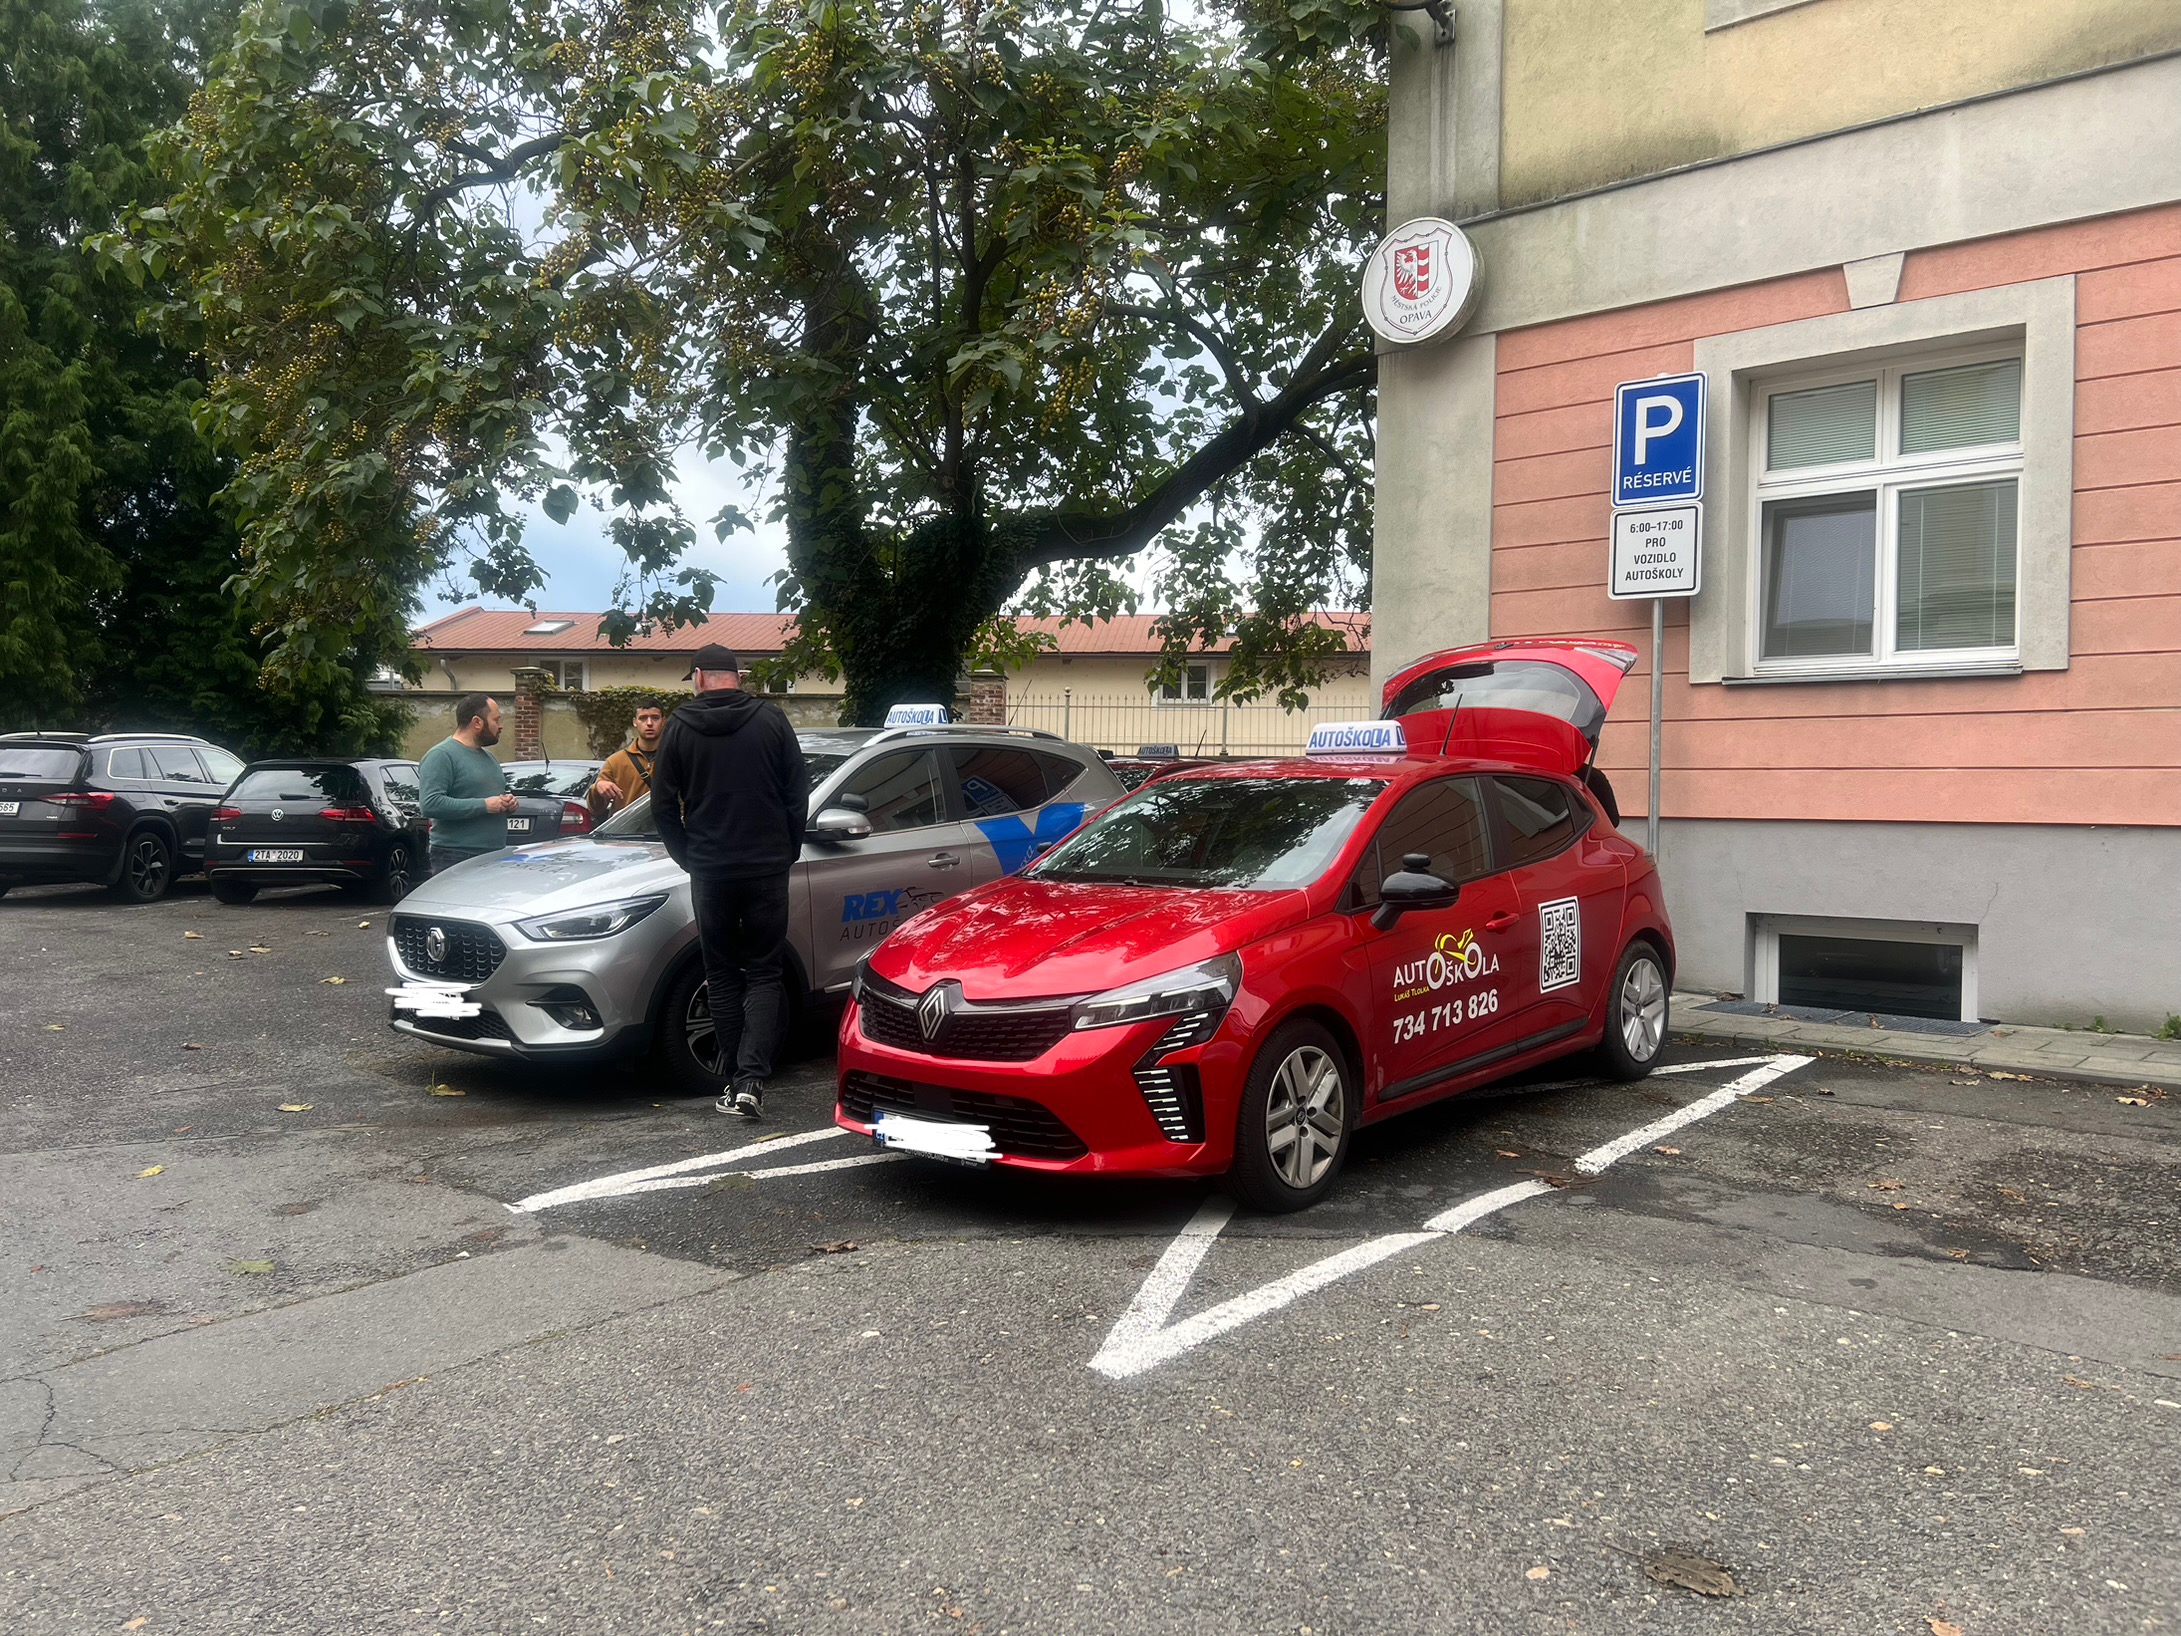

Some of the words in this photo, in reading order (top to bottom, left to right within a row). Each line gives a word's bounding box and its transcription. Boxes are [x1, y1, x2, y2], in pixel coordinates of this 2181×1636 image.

[1400, 310, 1432, 324] OPAVA
[1634, 395, 1684, 465] P
[1623, 466, 1692, 489] RÉSERVÉ
[1645, 537, 1666, 548] PRO
[1634, 552, 1677, 564] VOZIDLO
[1625, 567, 1684, 581] AUTOŠKOLY
[887, 708, 935, 725] AUTOŠKOLA
[1309, 726, 1391, 747] AUTOŠKOLA
[508, 820, 525, 829] 121
[254, 850, 271, 860] 2TA
[277, 850, 300, 859] 2020
[841, 888, 904, 923] REX
[1393, 942, 1500, 990] AUTOŠKOLA
[1393, 1011, 1426, 1045] 734
[1431, 1000, 1463, 1031] 713
[1468, 989, 1499, 1019] 826
